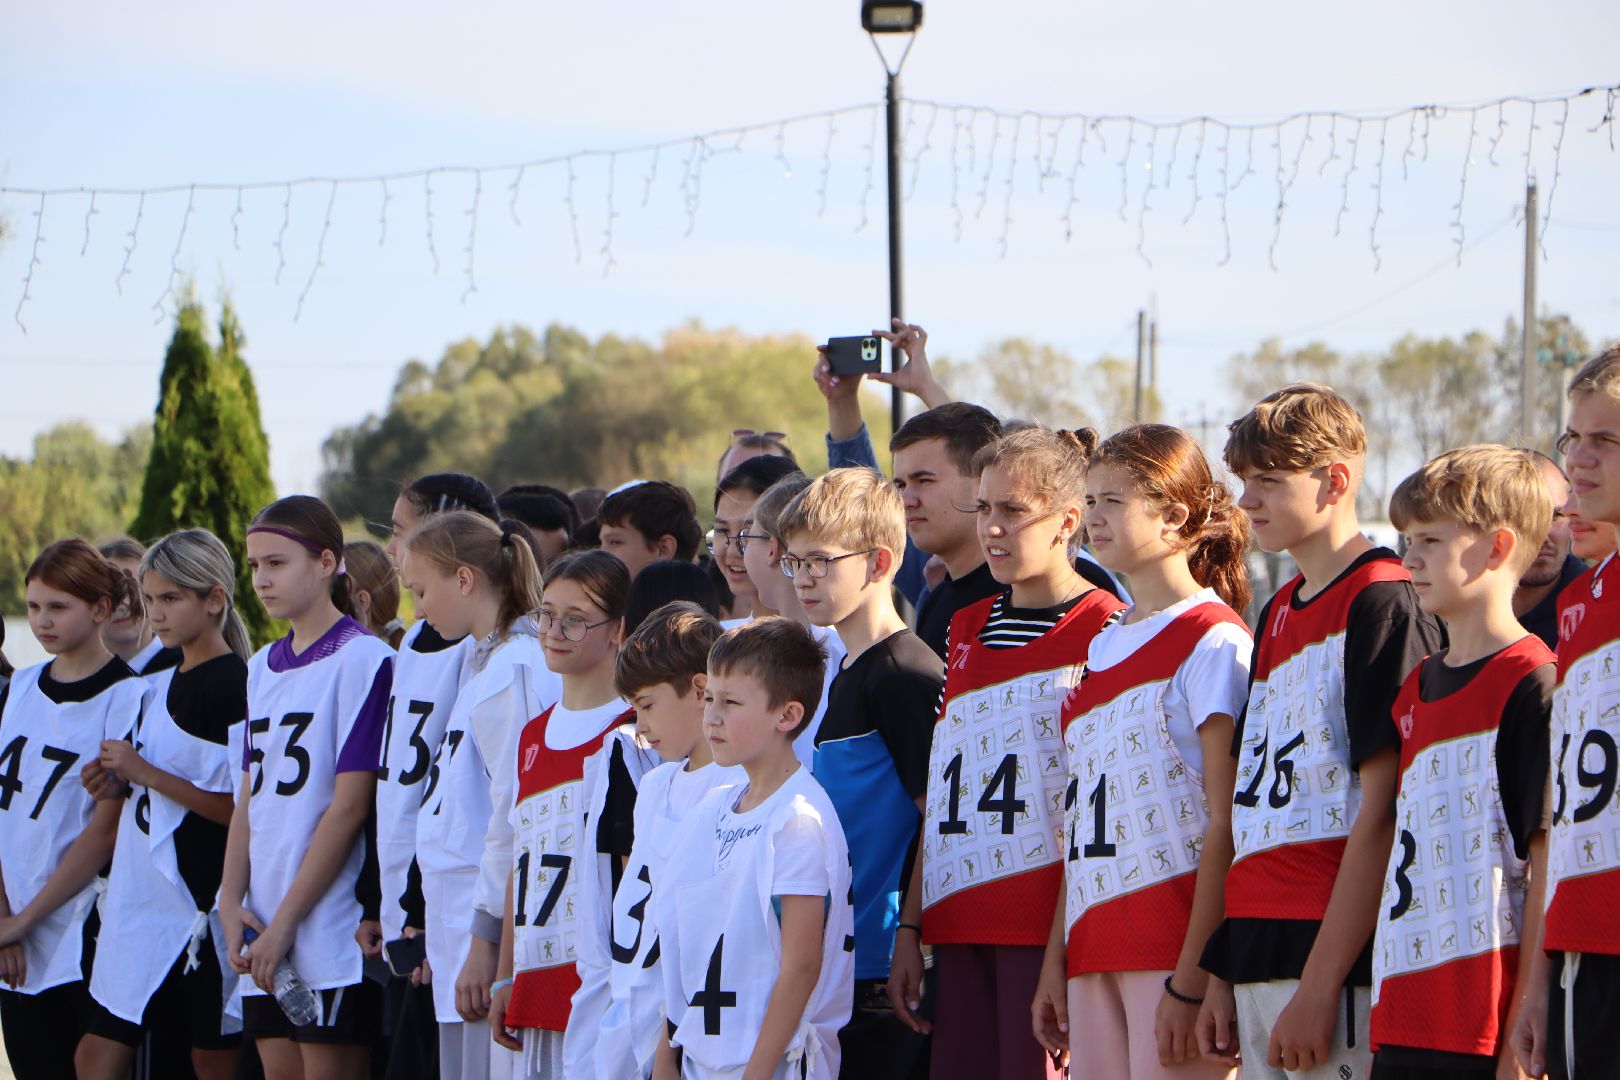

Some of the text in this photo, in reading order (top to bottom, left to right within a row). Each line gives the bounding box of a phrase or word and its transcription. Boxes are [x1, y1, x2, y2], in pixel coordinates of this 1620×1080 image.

[0, 735, 80, 820] 47
[378, 696, 434, 786] 13
[1234, 722, 1305, 809] 16
[939, 754, 1025, 834] 14
[515, 852, 572, 927] 17
